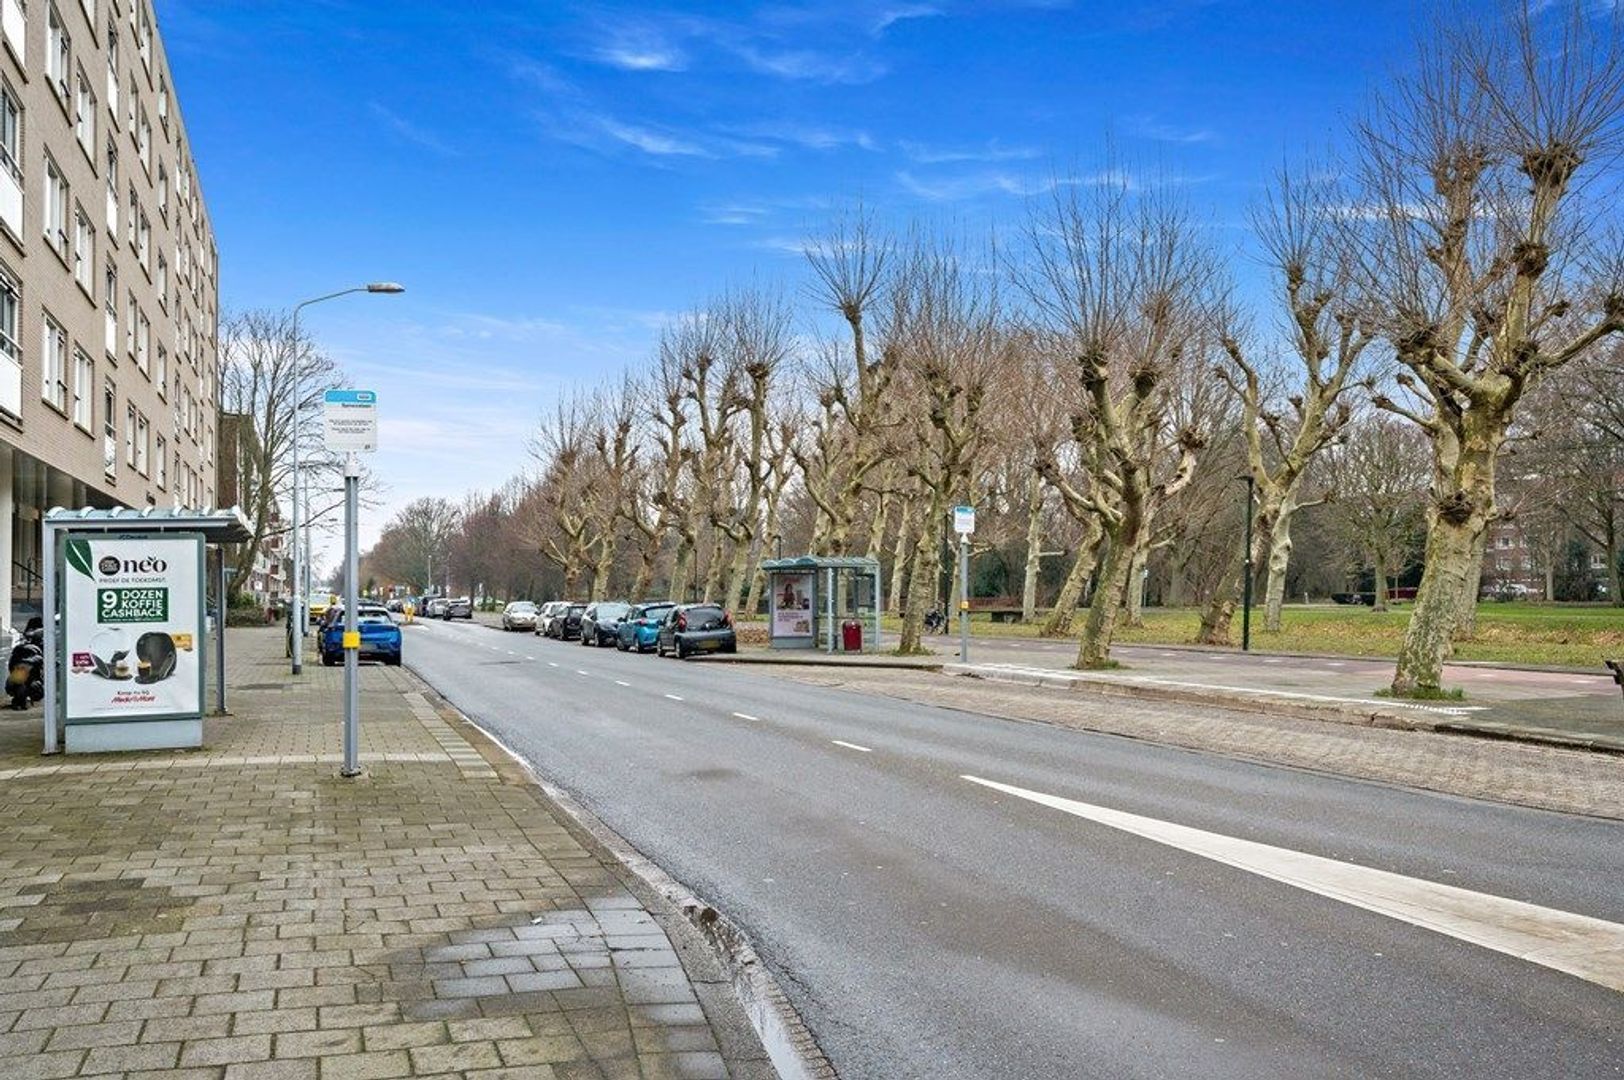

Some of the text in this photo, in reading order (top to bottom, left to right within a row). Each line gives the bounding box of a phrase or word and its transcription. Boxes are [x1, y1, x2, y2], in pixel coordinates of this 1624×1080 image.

[102, 590, 163, 608] 9 DOZEN
[121, 599, 163, 609] KOFFIE
[102, 608, 163, 618] CASHBACK
